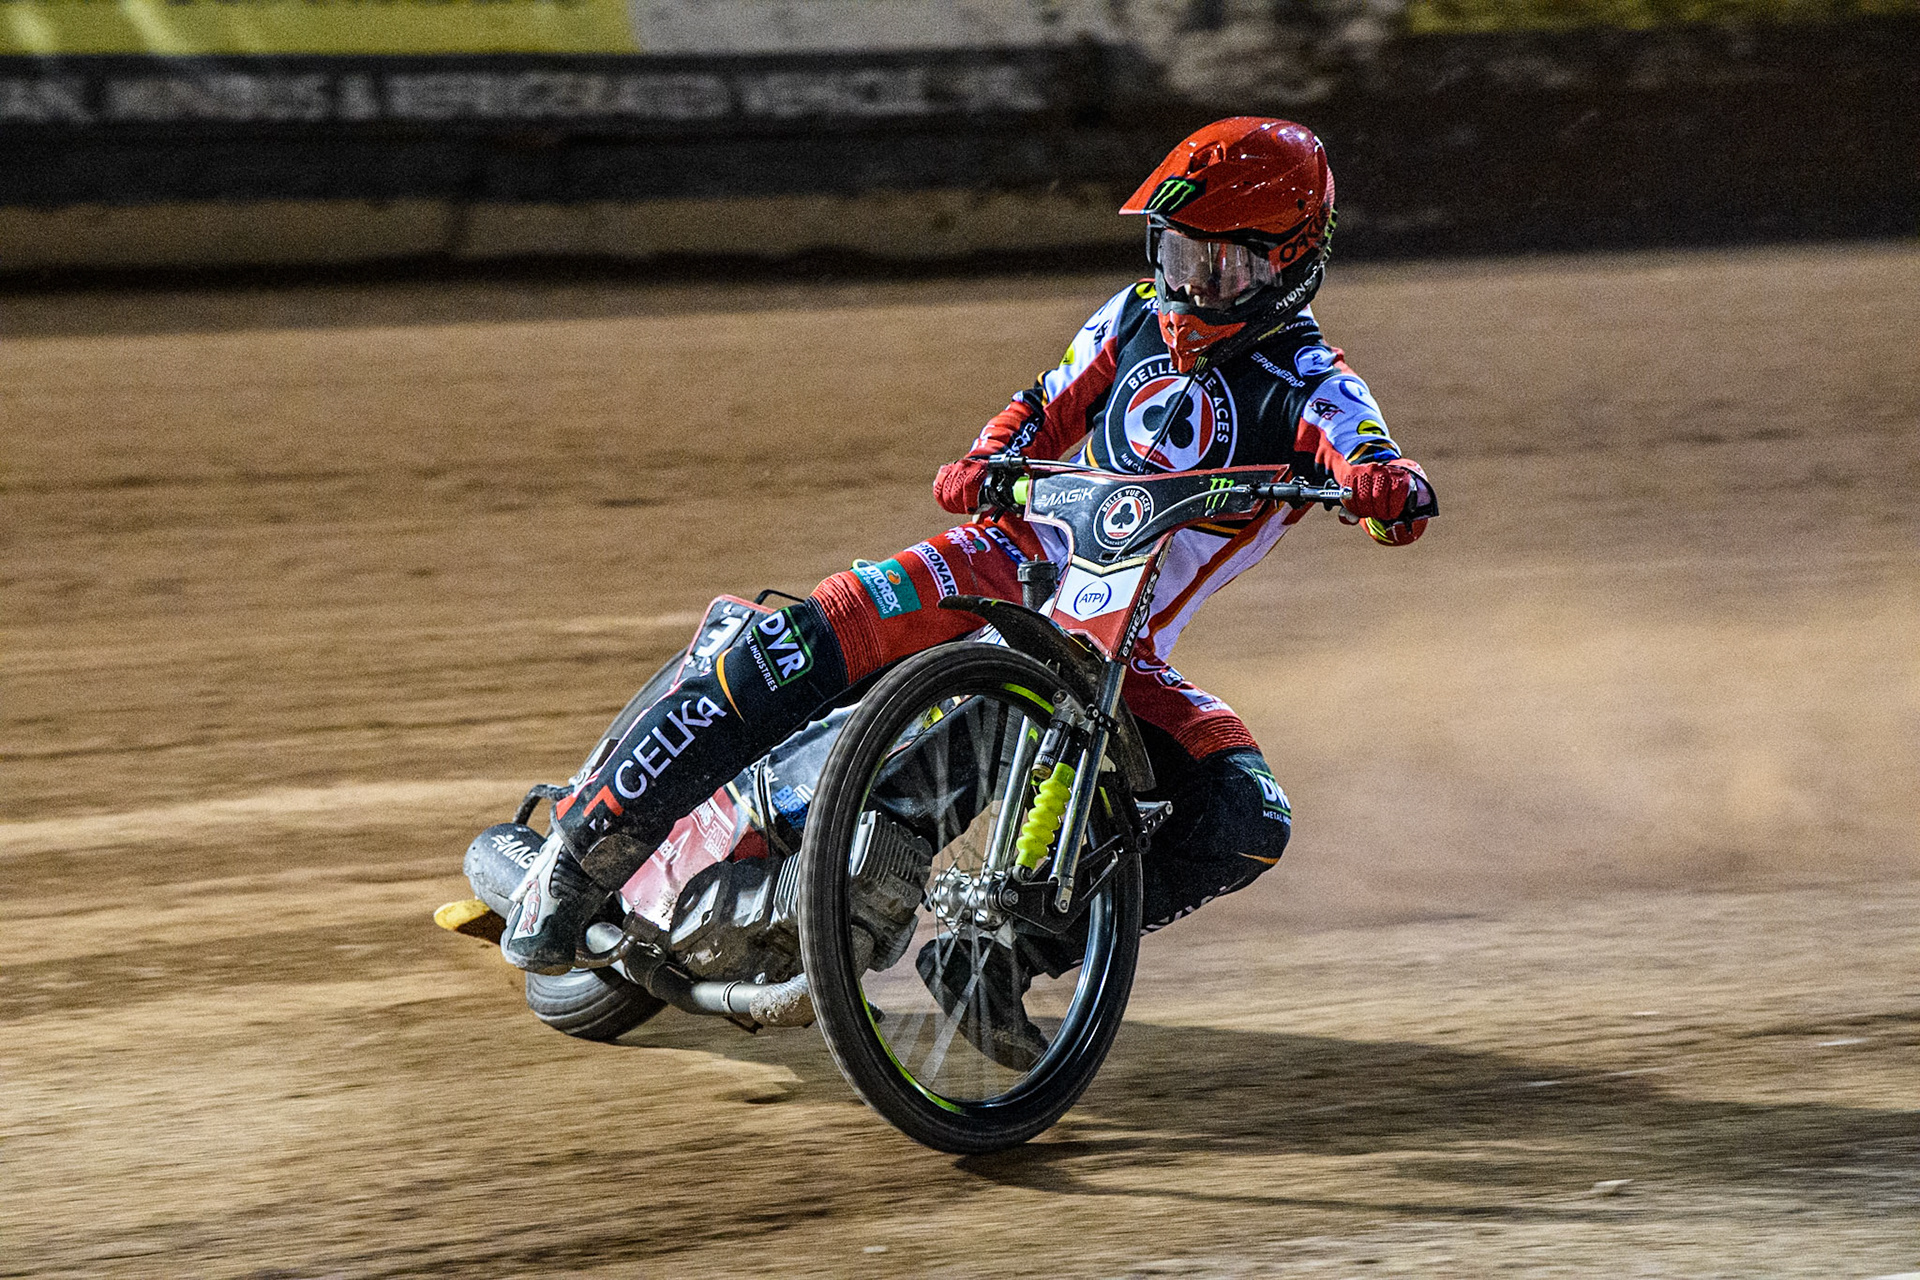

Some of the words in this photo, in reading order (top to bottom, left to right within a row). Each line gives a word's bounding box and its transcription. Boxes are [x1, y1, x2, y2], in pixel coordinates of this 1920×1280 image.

[1127, 362, 1178, 390] BELLE
[1212, 396, 1230, 444] ACES
[1102, 491, 1123, 512] BELLE
[1125, 489, 1141, 497] VUE
[1139, 494, 1151, 512] ACES
[864, 565, 902, 612] OTOREX
[1079, 592, 1105, 604] ATPI
[749, 644, 778, 692] INDUSTRIES
[758, 611, 806, 679] DVR
[614, 696, 728, 800] CELKA
